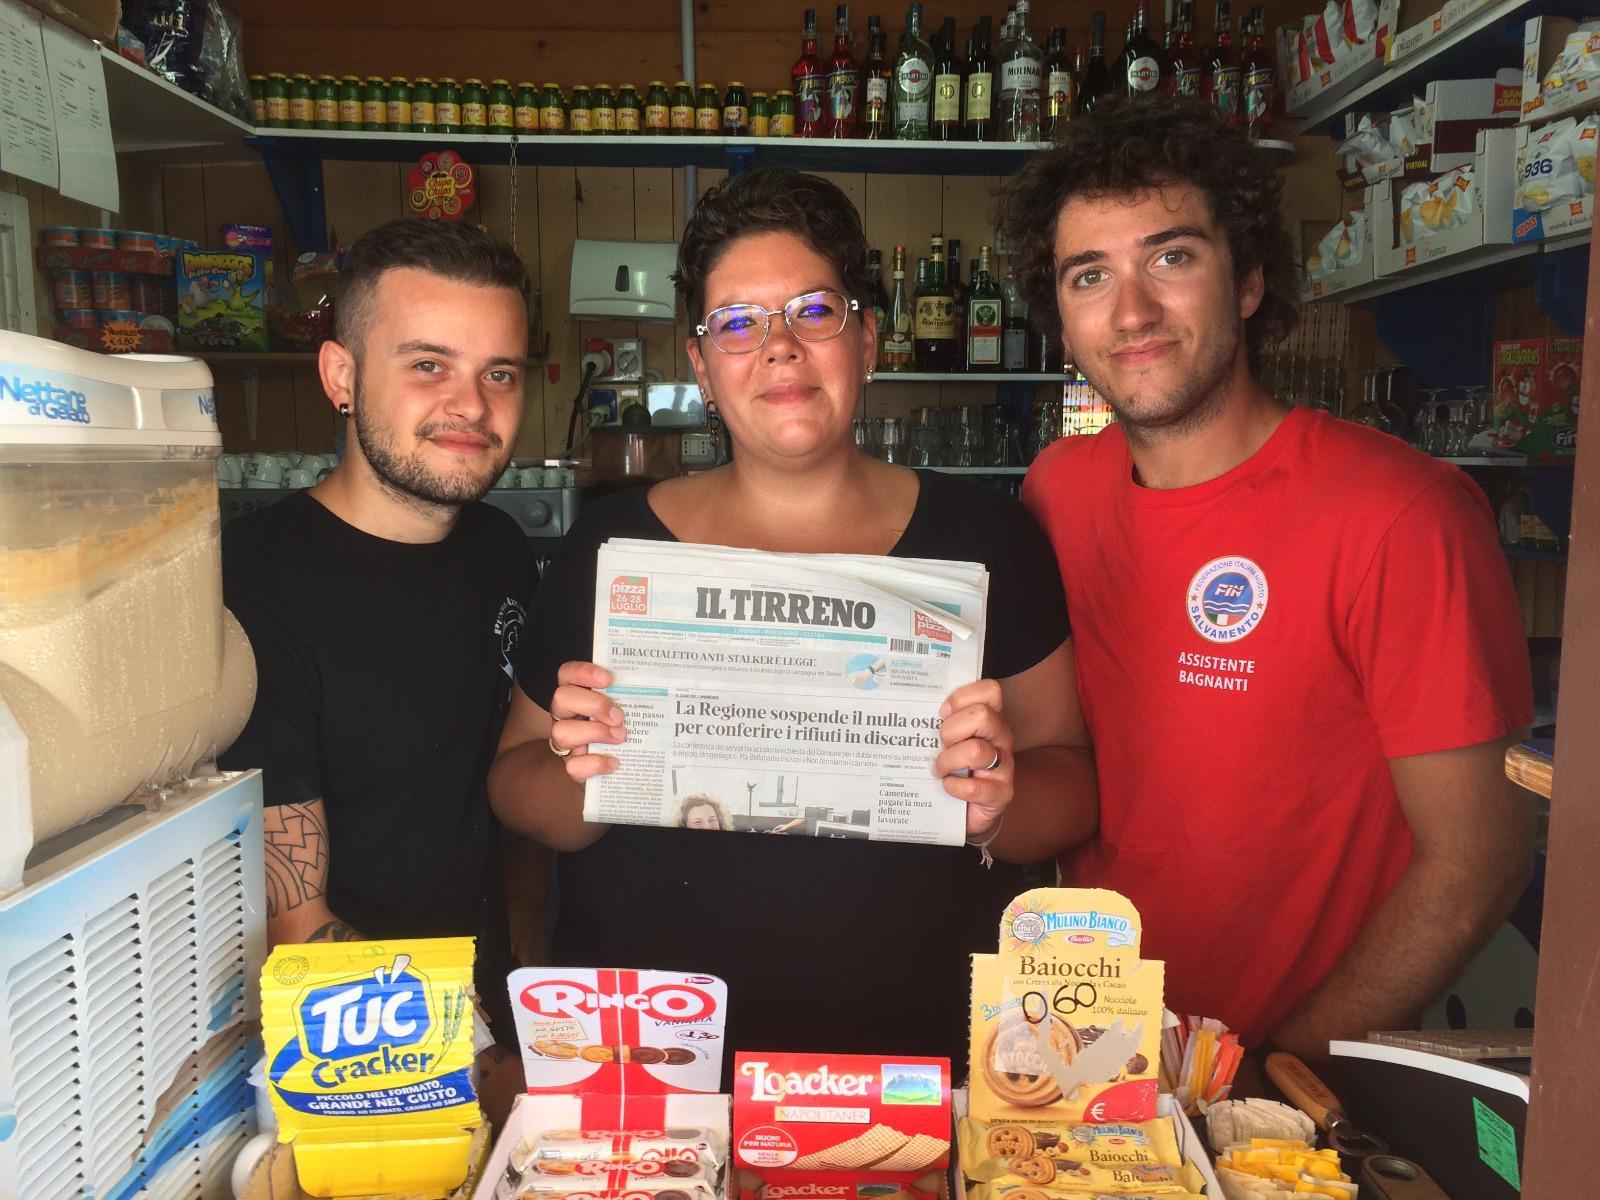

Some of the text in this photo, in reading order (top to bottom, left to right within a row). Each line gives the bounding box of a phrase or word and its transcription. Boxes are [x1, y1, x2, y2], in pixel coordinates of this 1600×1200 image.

[1194, 560, 1233, 592] FEDERAZIONE
[612, 582, 646, 595] pizza
[611, 601, 646, 612] LUGLIO
[695, 586, 876, 630] IL TIRRENO
[1191, 605, 1260, 640] SALVAMENTO
[622, 647, 699, 661] BRACCIALETTO
[700, 650, 774, 665] ANTI-STALKER
[782, 656, 817, 668] LEGGE
[1178, 651, 1255, 674] ASSISTENTE
[1179, 669, 1248, 692] BAGNANTI
[631, 720, 659, 730] pronto
[642, 712, 665, 721] passo
[675, 700, 944, 731] La Regione sospende il nulla osta
[674, 721, 704, 738] per
[706, 722, 783, 740] conferire
[795, 726, 842, 744] rifiuti
[845, 728, 861, 744] in
[864, 730, 939, 749] discarica
[878, 799, 904, 807] pagate
[879, 789, 919, 799] Cameriere
[877, 815, 909, 825] lavorate
[878, 806, 911, 816] delle ore
[1046, 910, 1127, 932] MULINO BIANCO
[1018, 954, 1121, 979] Baiocchi
[525, 982, 706, 1018] RINGO
[1092, 1006, 1115, 1015] 100%
[311, 1046, 435, 1089] Cracker
[316, 1079, 444, 1103] PICCOLO NEL FORMATO,
[741, 1061, 875, 1103] Loacker
[308, 1087, 457, 1111] GRANDE NEL GUSTO
[780, 1108, 867, 1122] NAPOLITANER
[760, 1141, 793, 1149] NATURA
[1089, 1149, 1149, 1163] Baiocchi
[579, 1160, 662, 1176] RINGO
